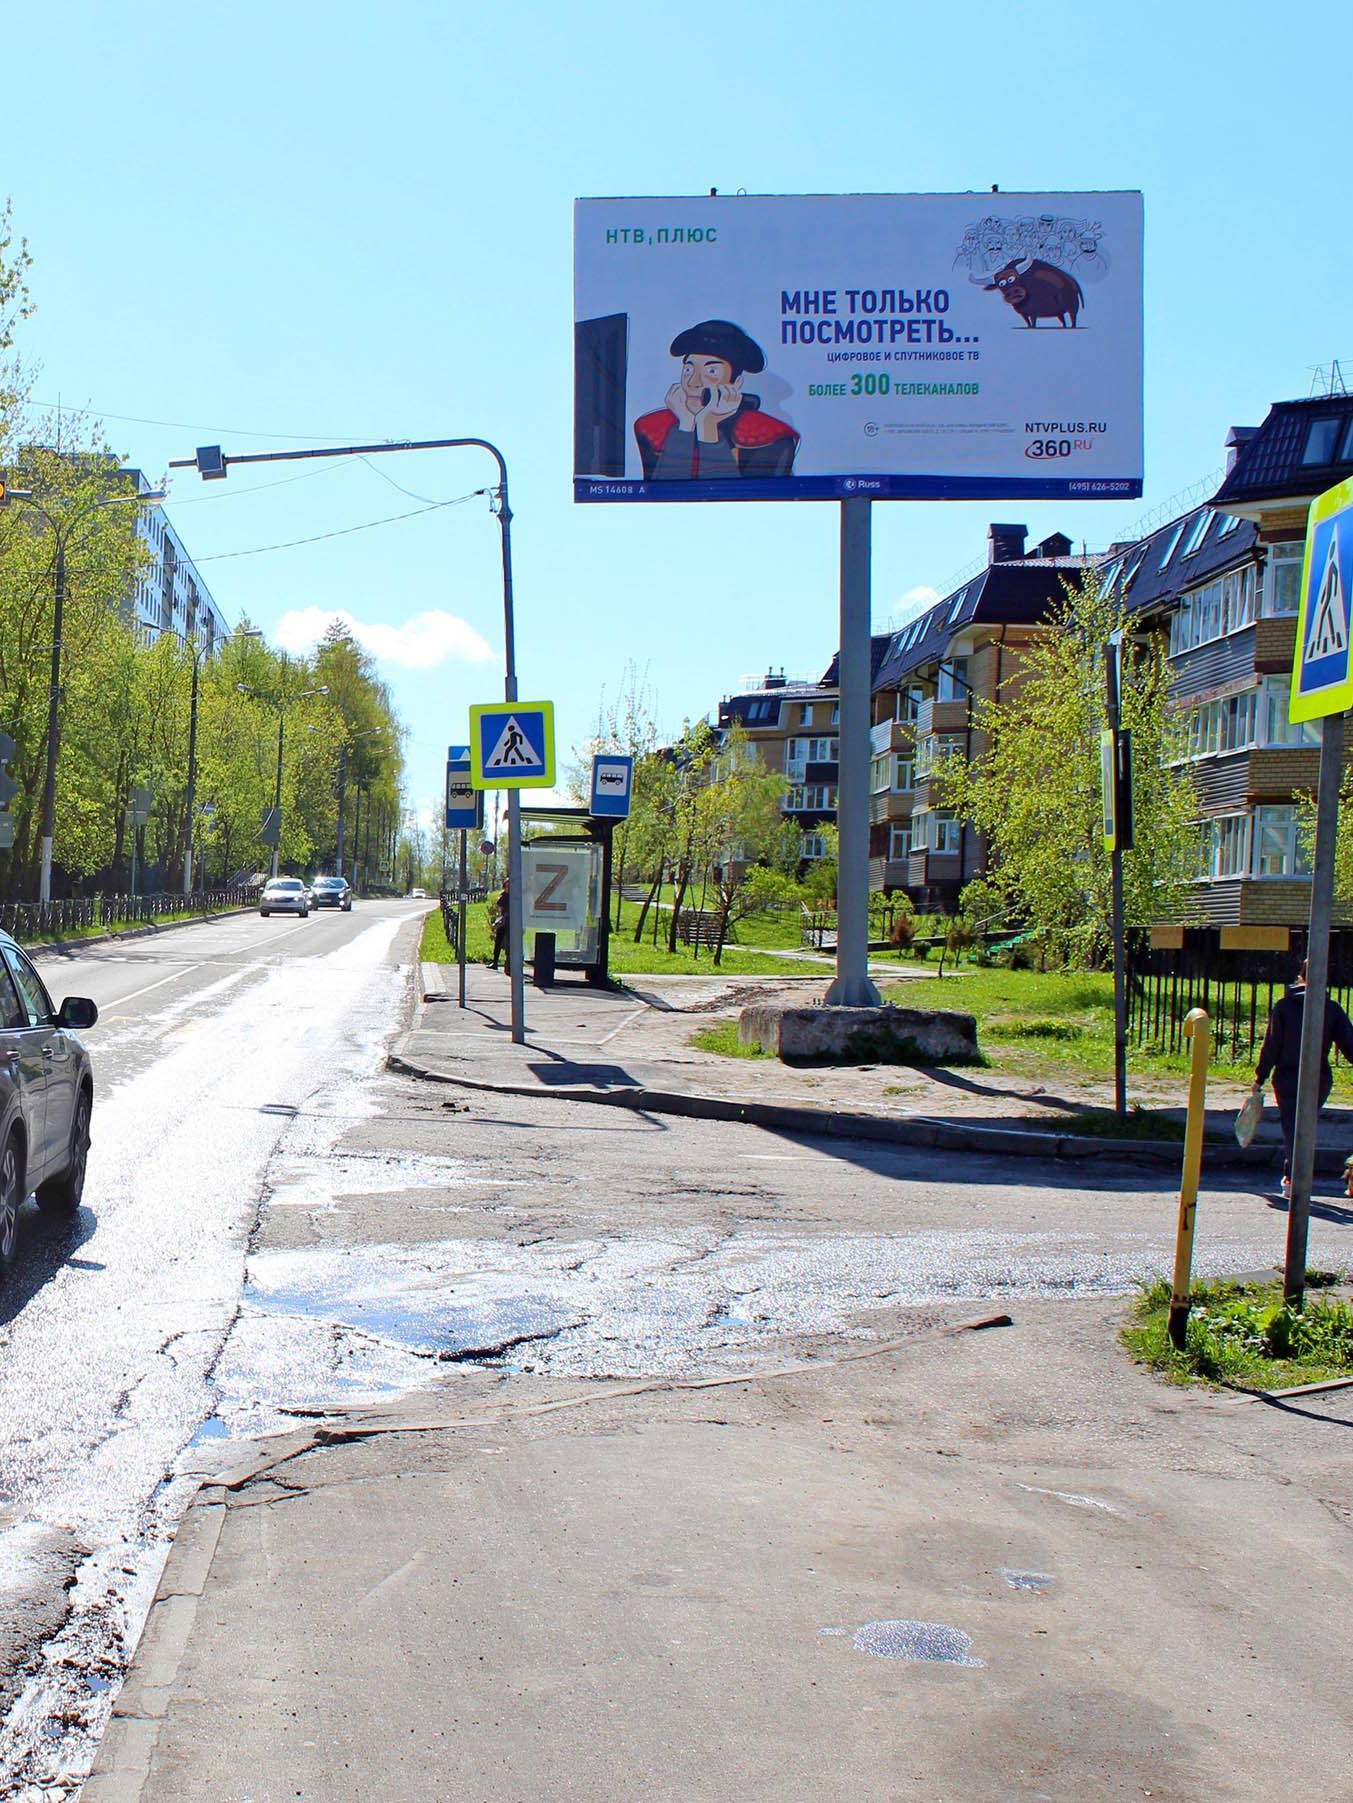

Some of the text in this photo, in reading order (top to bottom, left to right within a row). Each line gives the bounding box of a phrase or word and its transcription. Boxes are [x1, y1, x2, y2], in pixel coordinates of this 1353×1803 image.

[781, 289, 950, 315] МНЕ ТОЛЬКО
[781, 319, 980, 344] ПОСМОТРЕТЬ...
[827, 351, 980, 362] ЦИФРОВОЕ И СПУТНИКОВОЕ ТВ
[809, 373, 980, 396] БОЛЕЕ 300 ТЕЛЕКАНАЛОВ
[1025, 422, 1107, 433] NTVPLUS.RU
[1032, 440, 1071, 457] 360
[639, 486, 646, 494] A
[1069, 482, 1090, 491] (495)
[535, 864, 568, 911] Z
